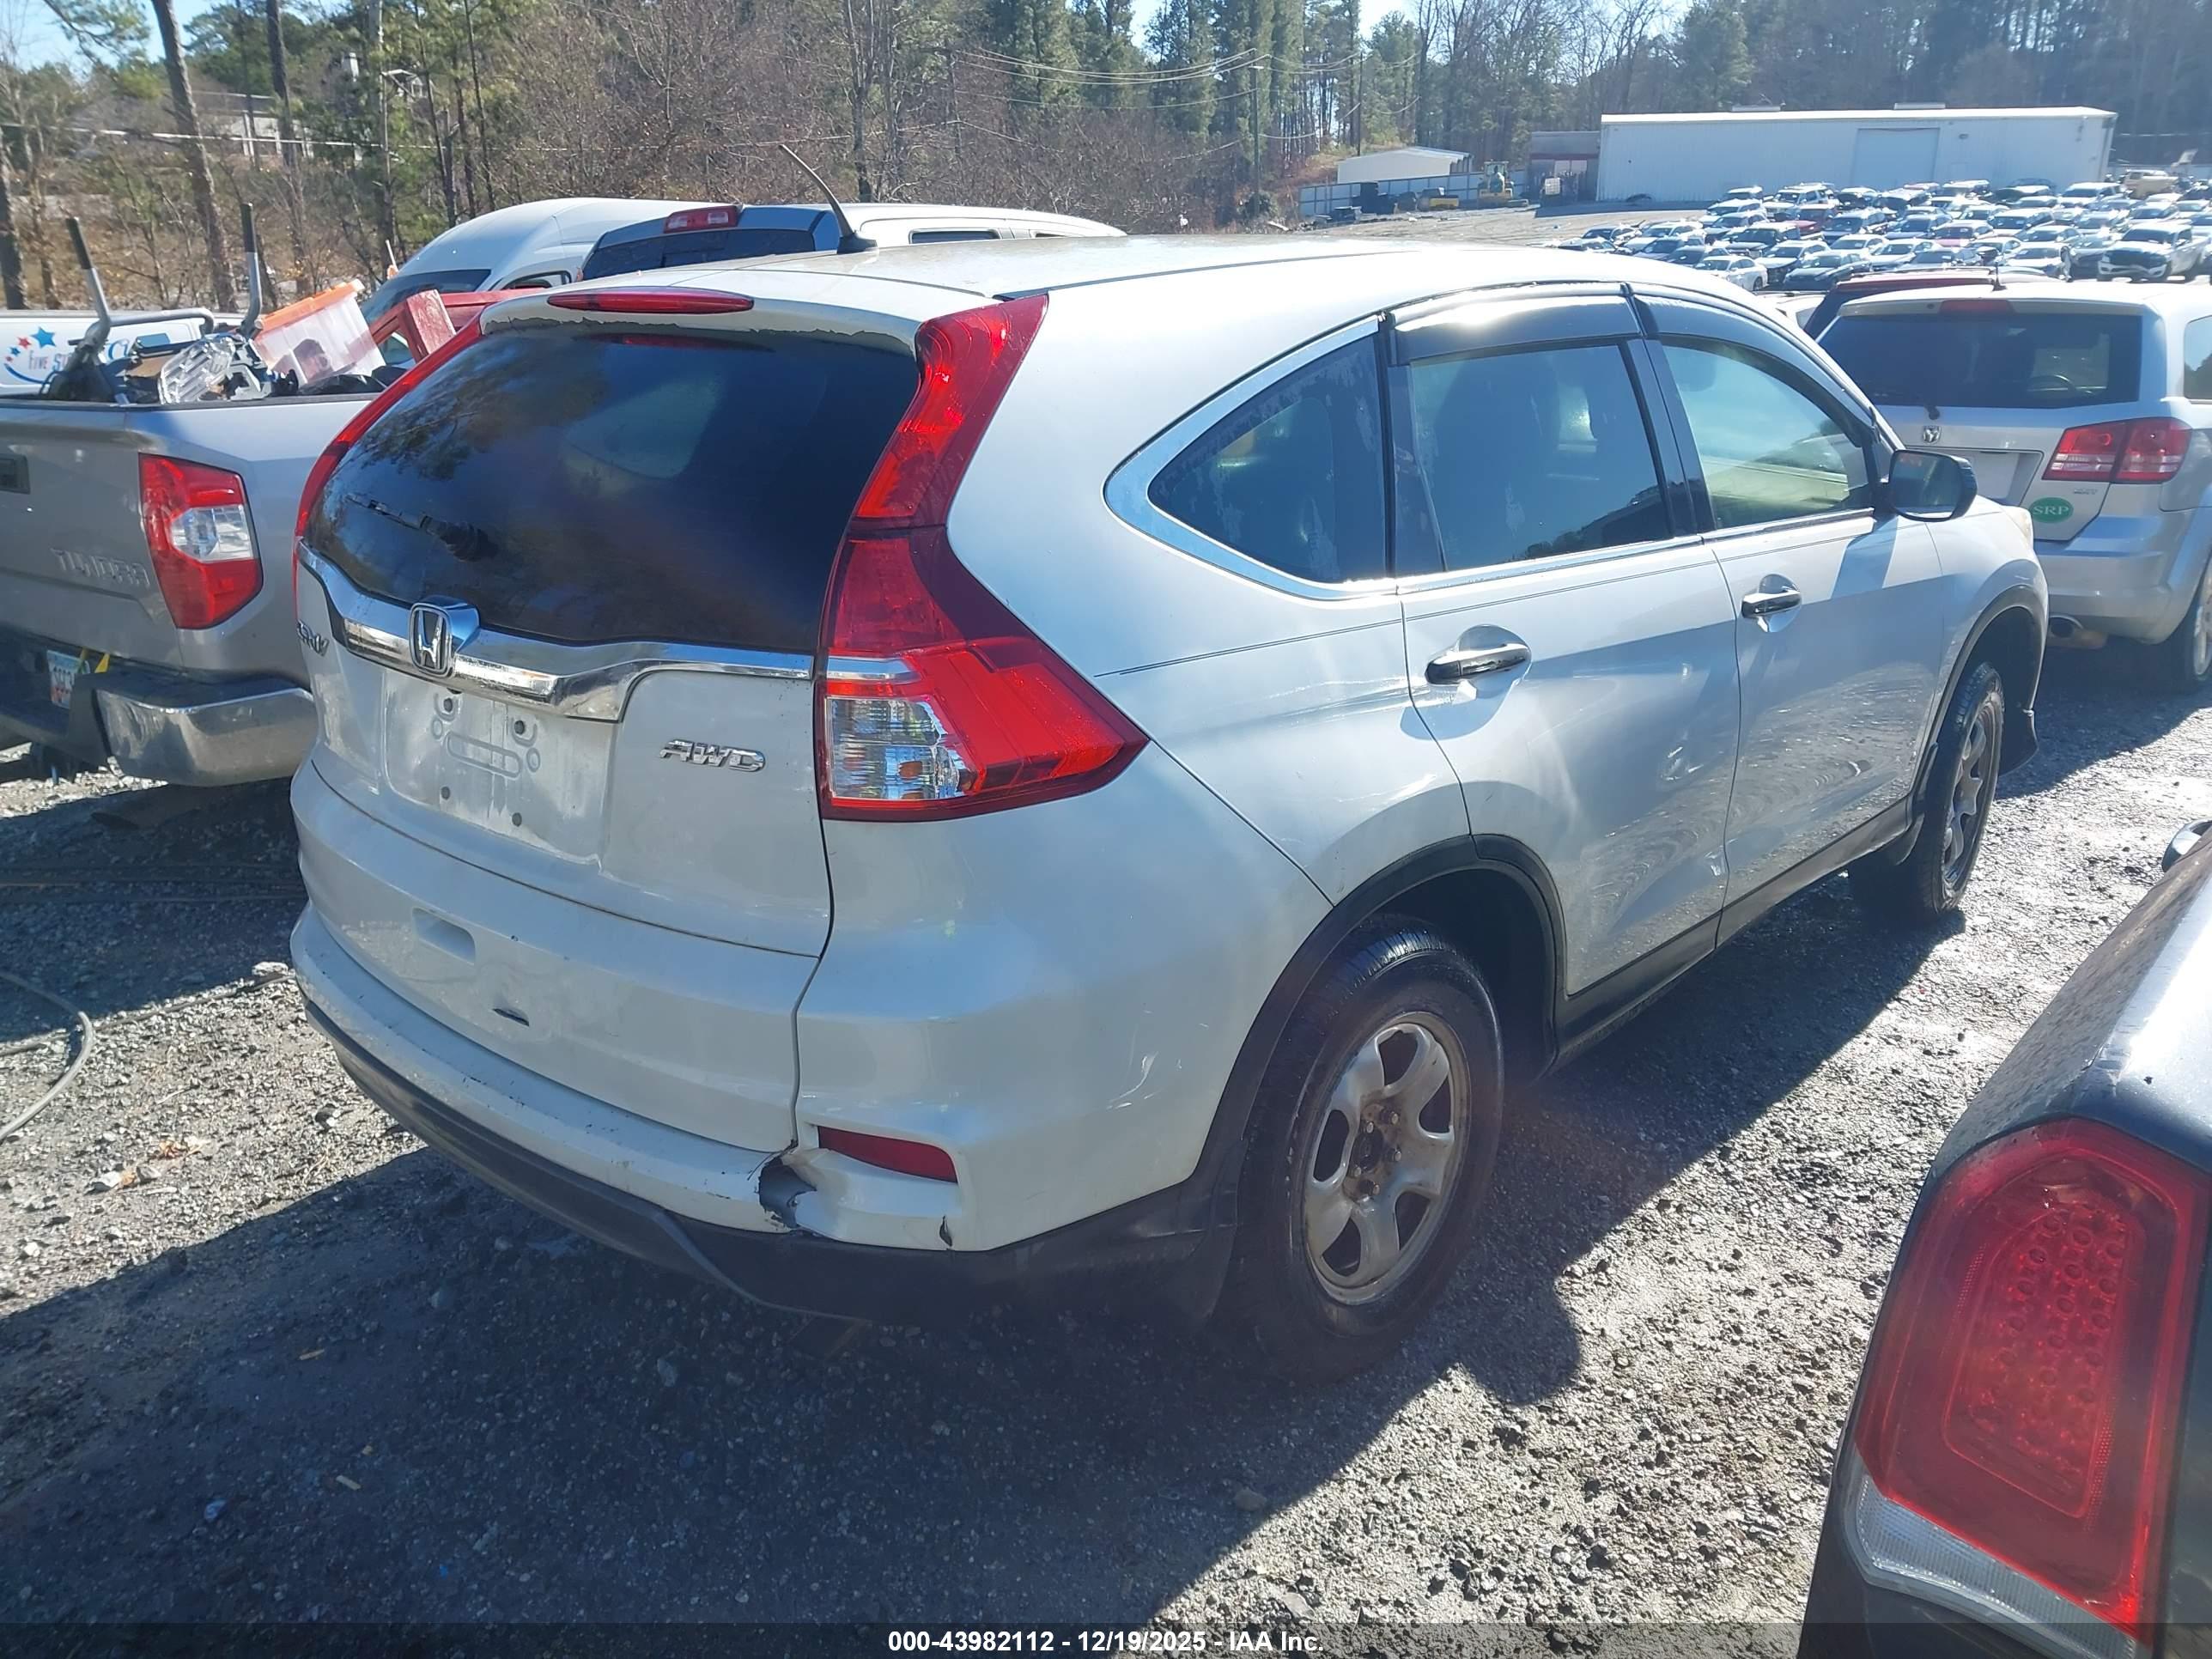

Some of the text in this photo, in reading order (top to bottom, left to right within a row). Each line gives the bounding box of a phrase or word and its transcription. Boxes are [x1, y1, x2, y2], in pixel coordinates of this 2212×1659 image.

[2033, 505, 2070, 516] SRP
[51, 548, 150, 587] TUNDRA
[659, 738, 766, 773] AWD
